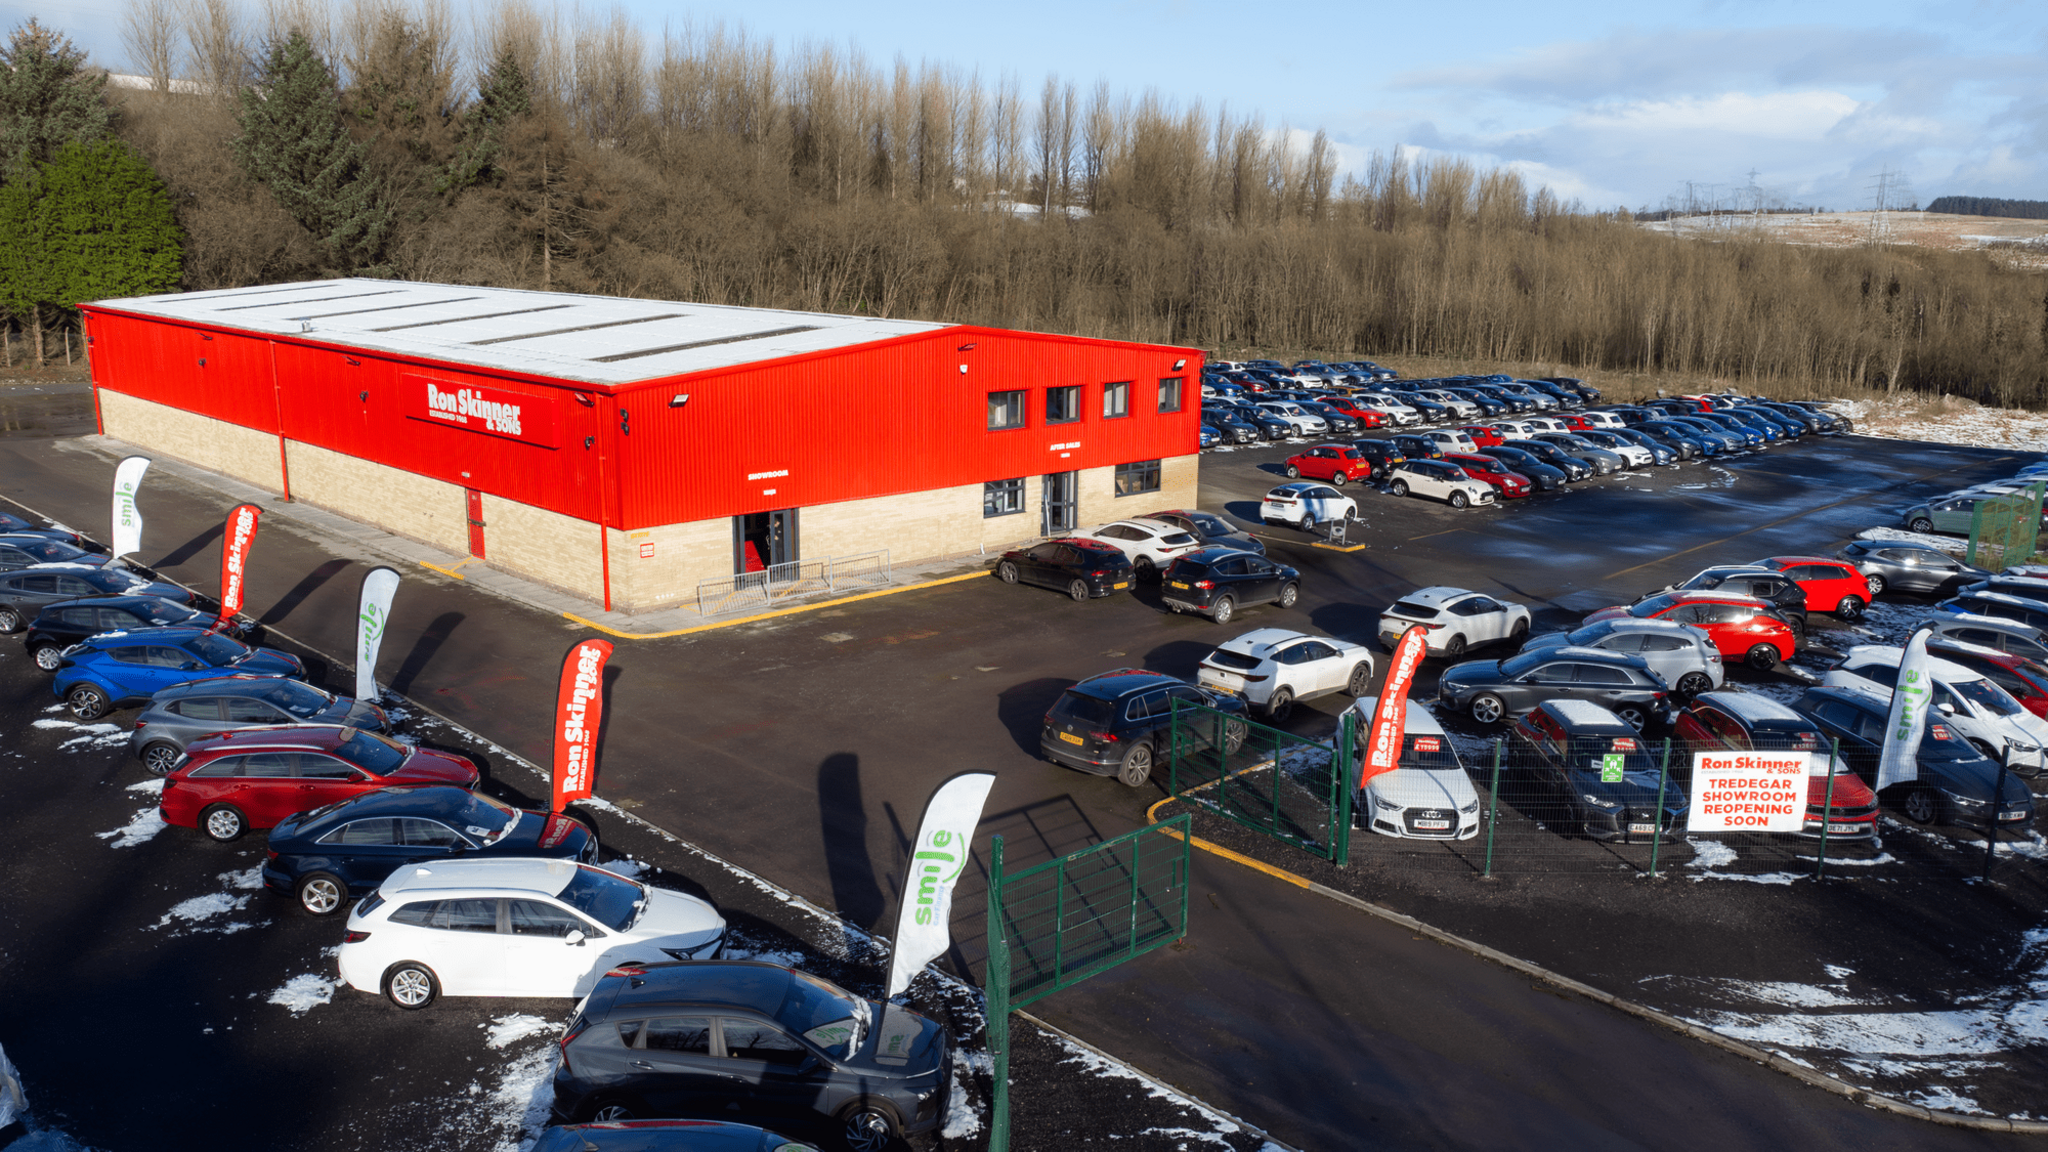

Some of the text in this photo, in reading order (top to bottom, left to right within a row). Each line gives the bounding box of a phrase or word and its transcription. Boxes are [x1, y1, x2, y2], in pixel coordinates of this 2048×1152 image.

[427, 383, 520, 420] Ron Skinner
[486, 417, 521, 435] & SONS
[748, 469, 789, 480] SHOWROOM
[115, 482, 134, 526] smile
[228, 507, 247, 573] Skinner
[224, 574, 238, 607] Ron
[585, 648, 601, 700] & SONS
[1371, 631, 1419, 767] Ron Skinner
[1897, 669, 1923, 741] smile
[563, 645, 593, 793] Ron Skinner
[1386, 726, 1397, 768] ESTABLISHED
[1701, 757, 1802, 769] Ron Skinner
[578, 748, 589, 791] ESTABLISHED
[1709, 778, 1792, 789] TREDEGAR
[1702, 791, 1797, 802] SHOWROOM
[1703, 803, 1793, 815] REOPENING
[1724, 816, 1769, 827] SOON
[915, 829, 955, 925] smile
